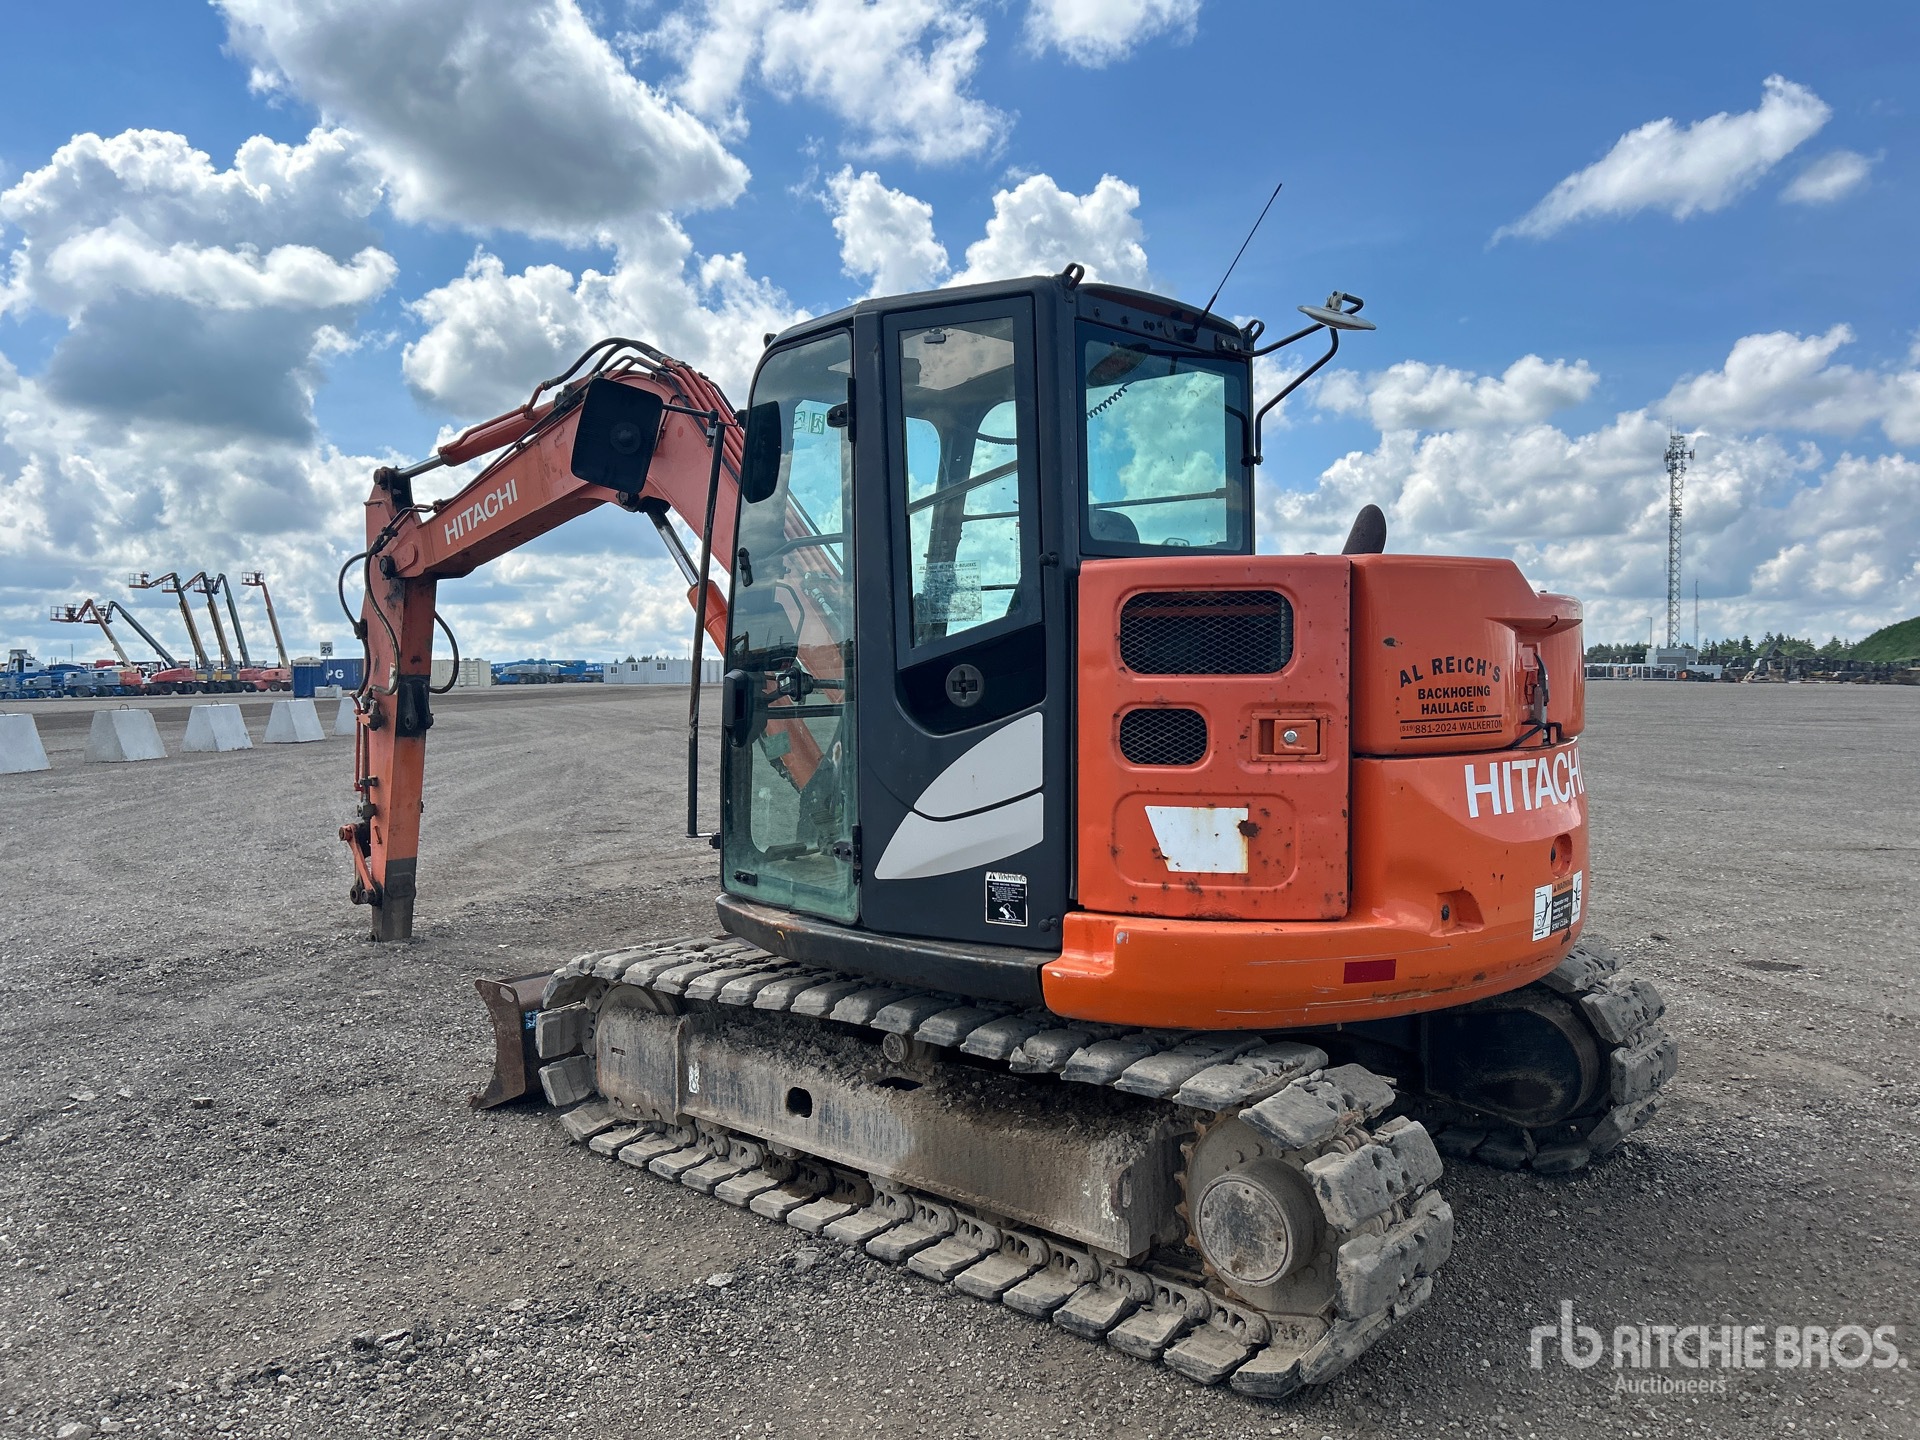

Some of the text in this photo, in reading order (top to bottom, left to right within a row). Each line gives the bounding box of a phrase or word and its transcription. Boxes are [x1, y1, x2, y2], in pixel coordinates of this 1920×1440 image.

[443, 479, 518, 545] HITACHI
[321, 646, 332, 654] 29
[1400, 665, 1423, 688] AL
[1418, 685, 1490, 699] BACKHOEING
[1421, 701, 1474, 715] HAULAGE
[1459, 719, 1502, 731] WALKERTON
[1464, 747, 1585, 818] HITACHI
